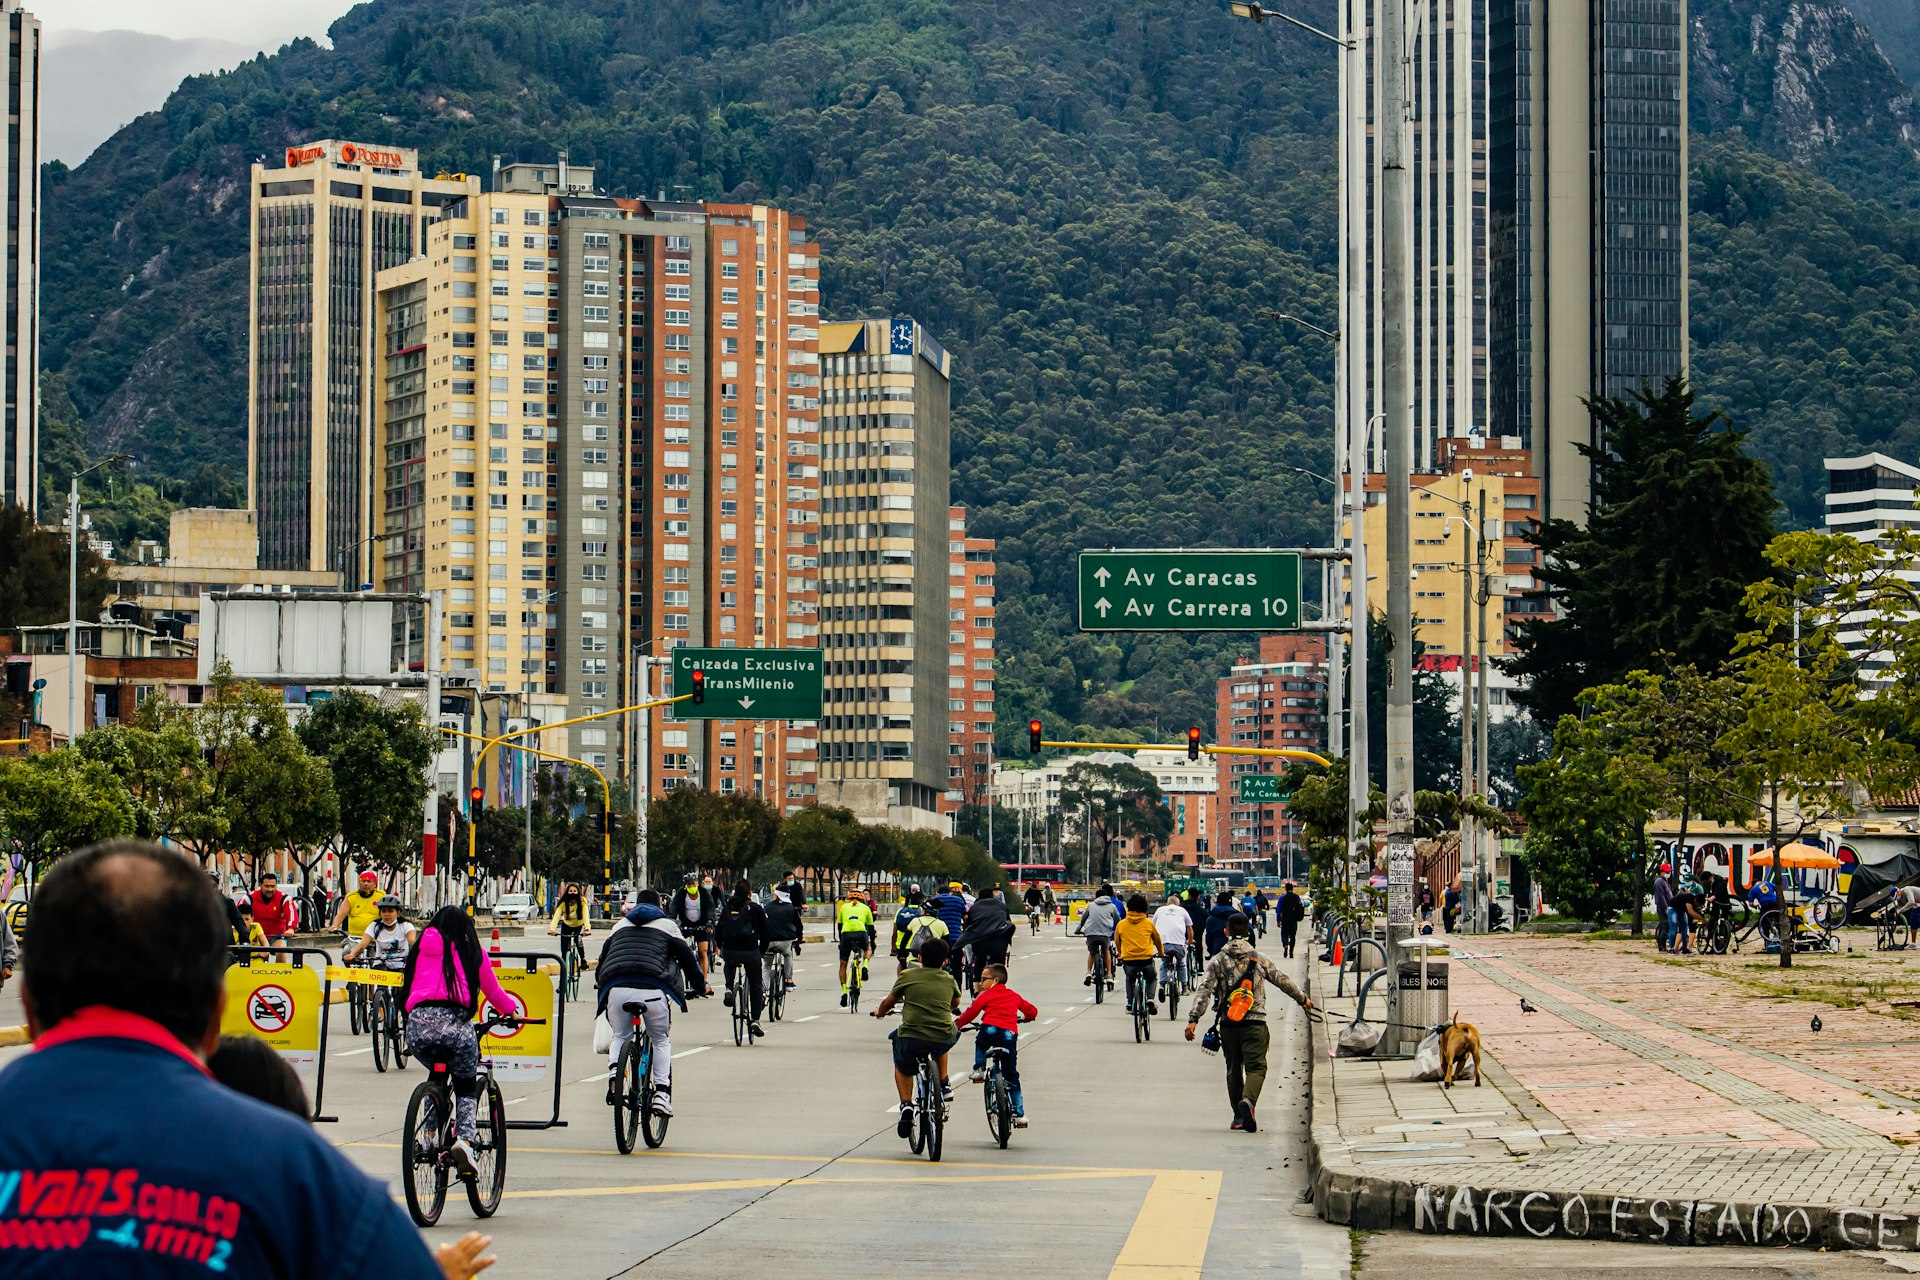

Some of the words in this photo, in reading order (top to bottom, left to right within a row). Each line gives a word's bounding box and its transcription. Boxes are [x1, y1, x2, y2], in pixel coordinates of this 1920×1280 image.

[358, 147, 403, 165] POSITIVA
[1124, 568, 1155, 585] Av
[1168, 567, 1257, 586] Caracas
[1124, 598, 1155, 616] Av
[1168, 598, 1251, 616] Carrera
[1262, 598, 1288, 616] 10
[681, 657, 738, 670] Calzada
[745, 658, 815, 671] Exclusiva
[703, 677, 794, 690] TransMilenio
[368, 973, 388, 982] IDRD
[1401, 978, 1420, 986] BLES
[1415, 1184, 1590, 1238] NARCO
[1611, 1195, 1812, 1244] ESTADO
[1838, 1208, 1920, 1250] GE
